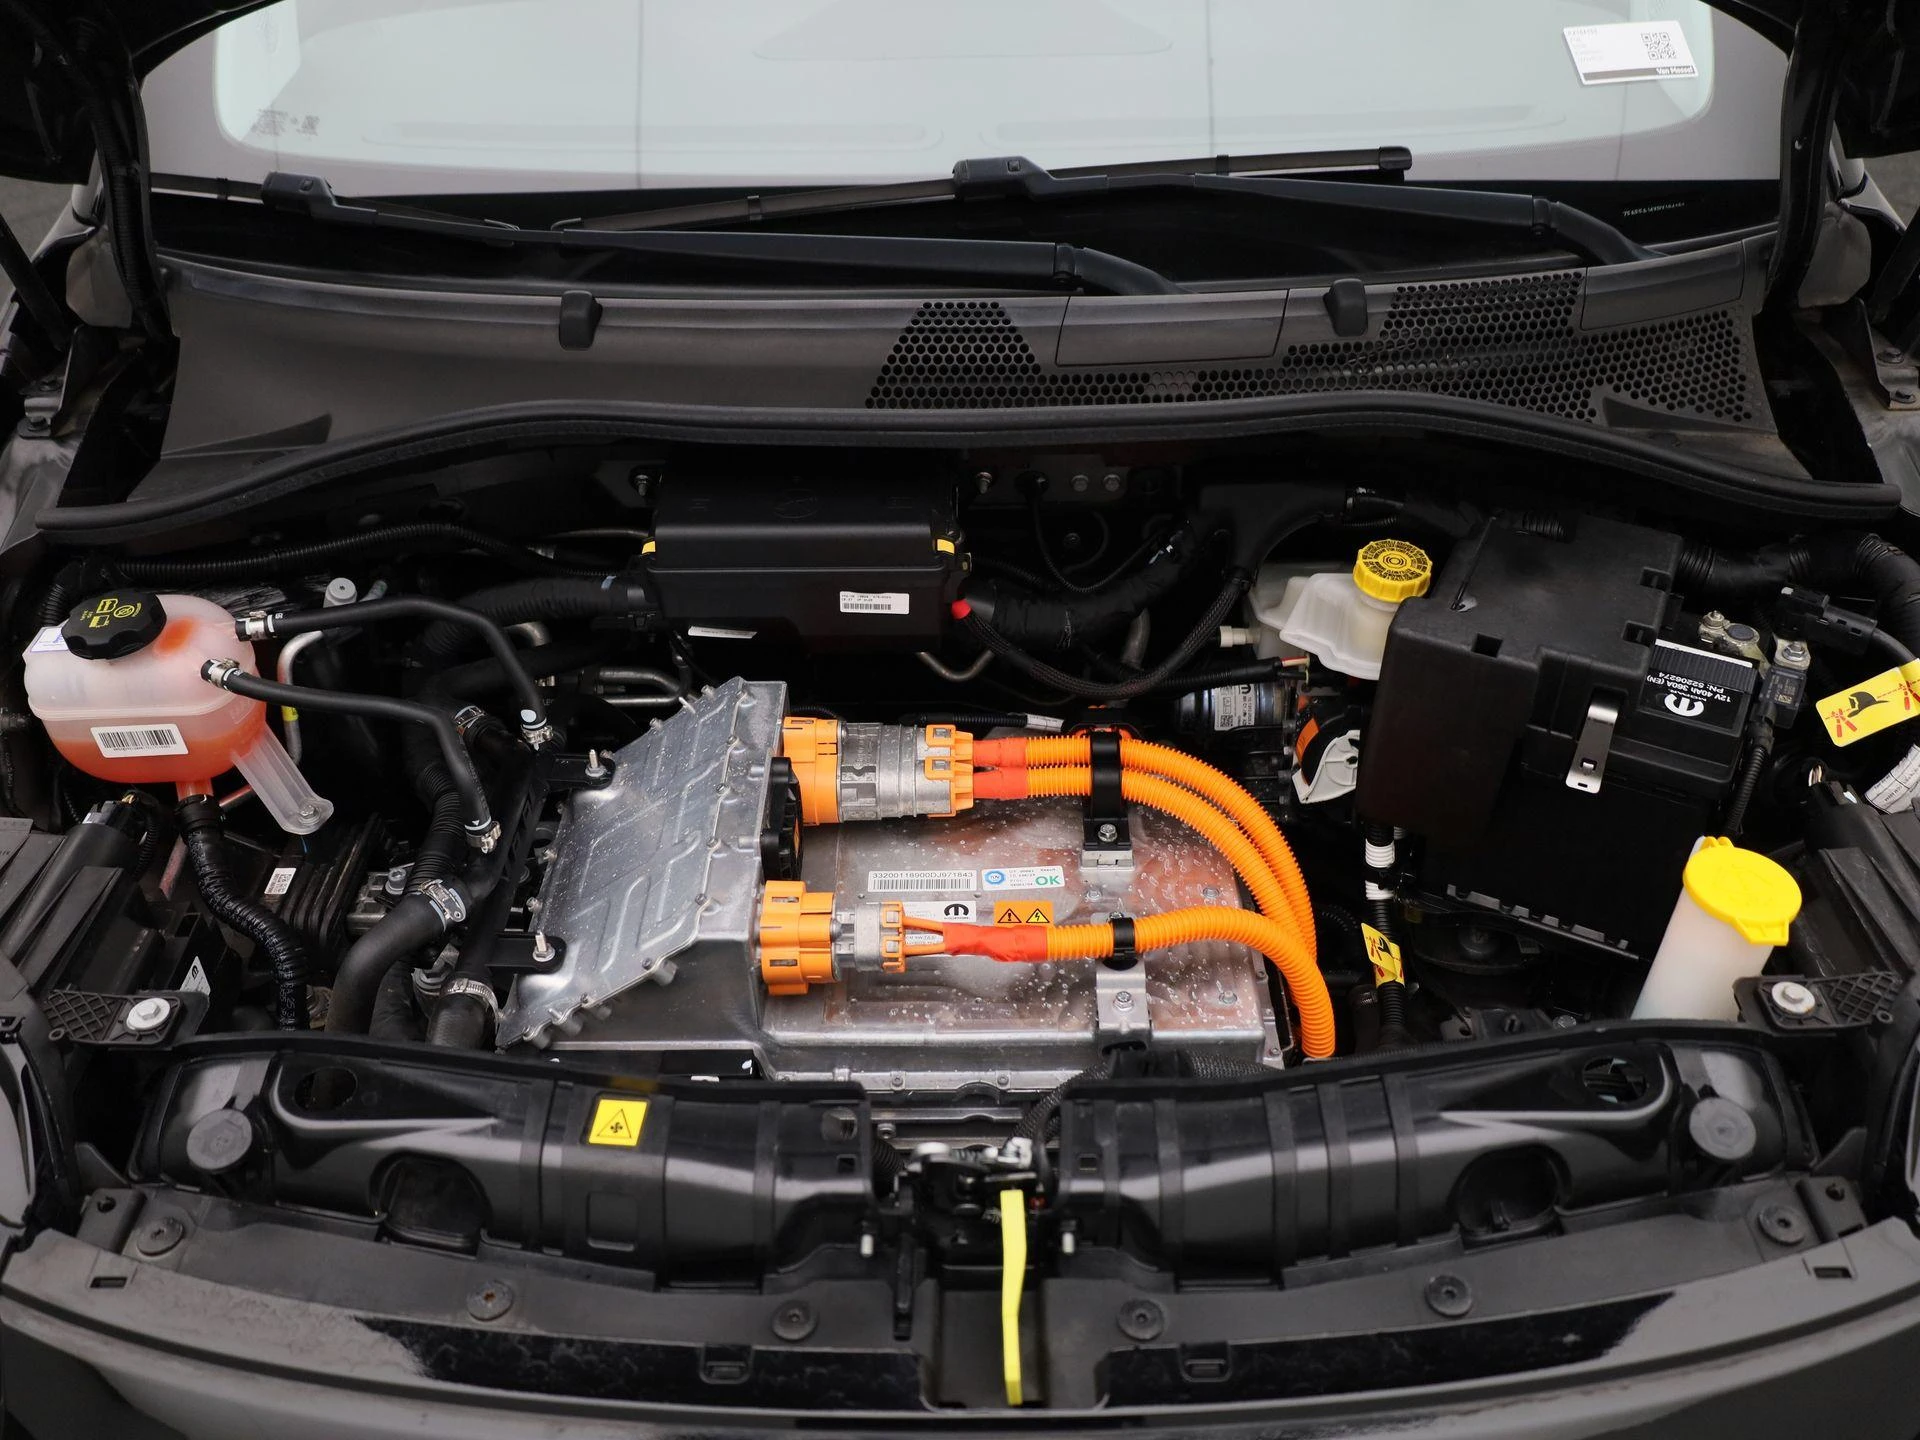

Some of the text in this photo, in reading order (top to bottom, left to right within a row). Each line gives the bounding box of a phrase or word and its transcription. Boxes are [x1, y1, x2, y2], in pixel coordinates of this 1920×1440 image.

[1646, 675, 1731, 703] 12V 40Ah 360A (EN)
[1035, 875, 1060, 886] OK
